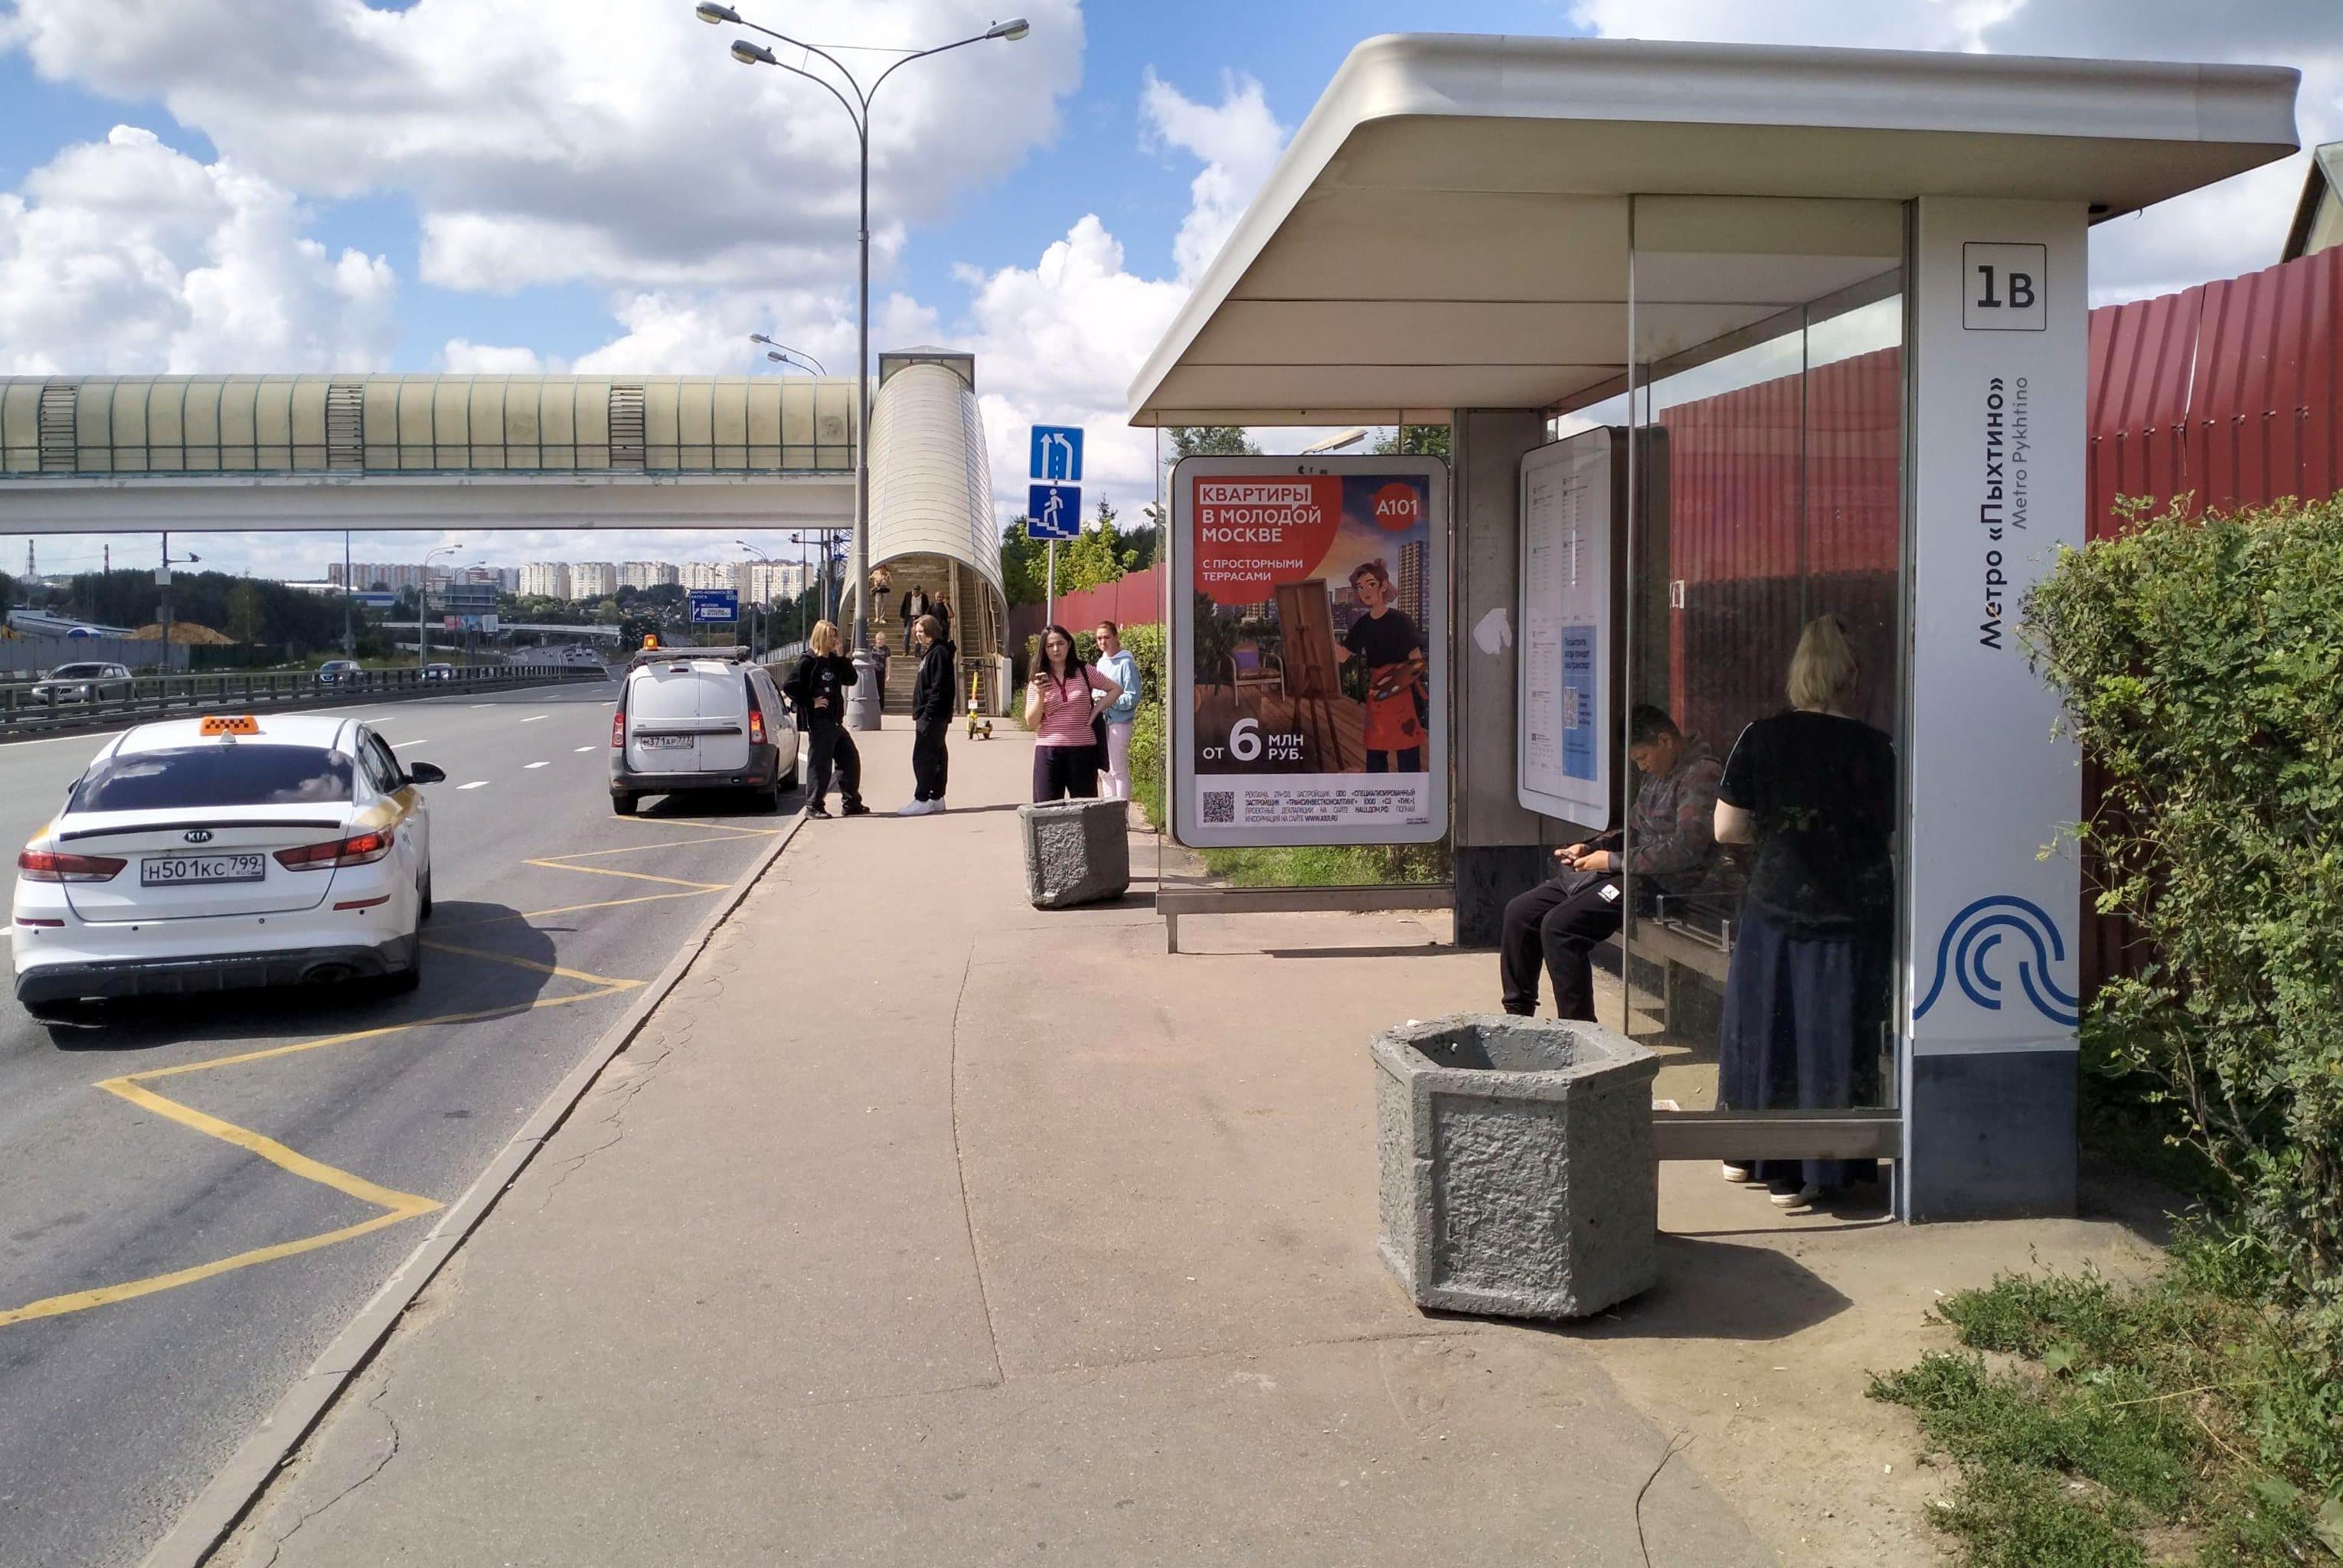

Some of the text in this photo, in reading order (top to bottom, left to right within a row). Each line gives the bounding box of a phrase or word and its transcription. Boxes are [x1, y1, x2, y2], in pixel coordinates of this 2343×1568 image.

[2011, 377, 2031, 530] Metro Pykhtino
[1202, 487, 1309, 502] КВАРТИРЫ
[1376, 498, 1418, 515] А101
[1980, 377, 2008, 651] Метро «Пыхтино»
[1202, 505, 1322, 527] В МОЛОДОЙ
[1202, 528, 1283, 542] МОСКВЕ
[1202, 559, 1303, 569] С ПРОСТОРНЫМИ
[1202, 572, 1272, 582] ТЕРРАСАМИ
[1202, 717, 1304, 762] ОТ 6 МЛН
[1268, 748, 1304, 760] РУБ.
[188, 832, 209, 841] KIA
[230, 856, 259, 871] 799
